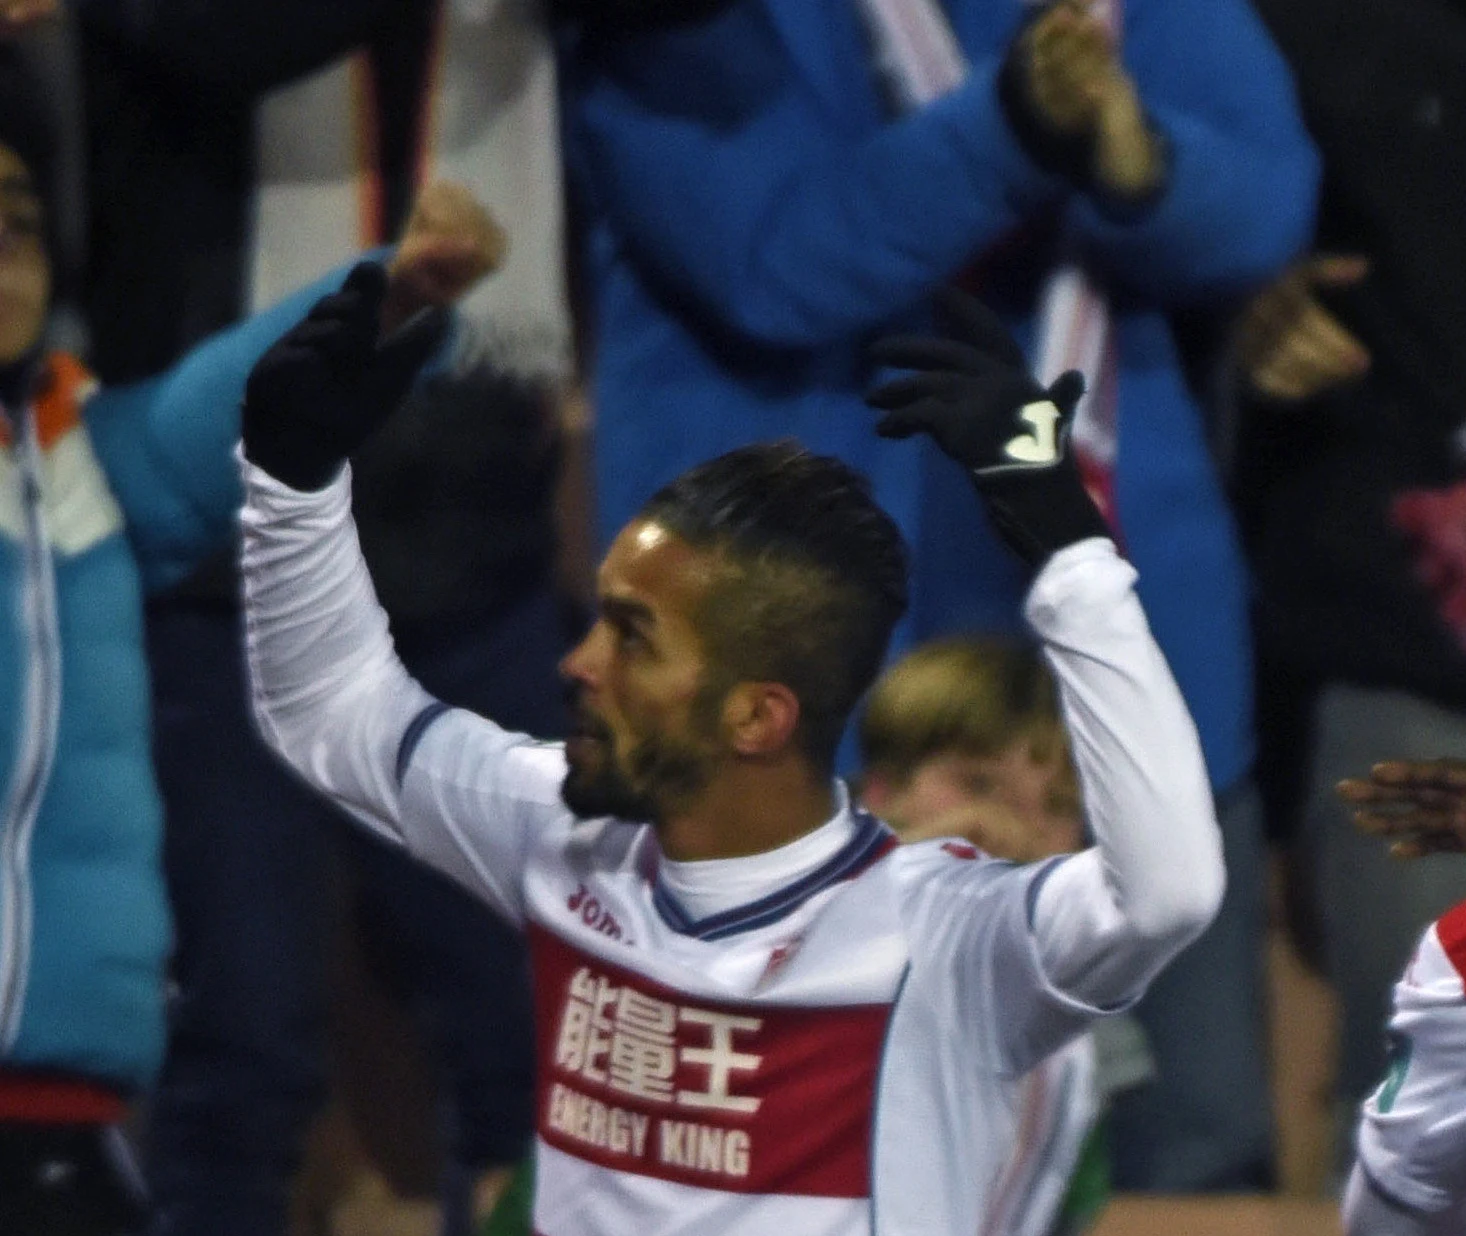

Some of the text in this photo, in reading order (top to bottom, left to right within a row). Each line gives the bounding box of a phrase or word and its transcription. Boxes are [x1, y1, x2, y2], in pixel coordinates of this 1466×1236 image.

[556, 966, 765, 1114] 能量王
[549, 1083, 750, 1177] ENERGY KING
